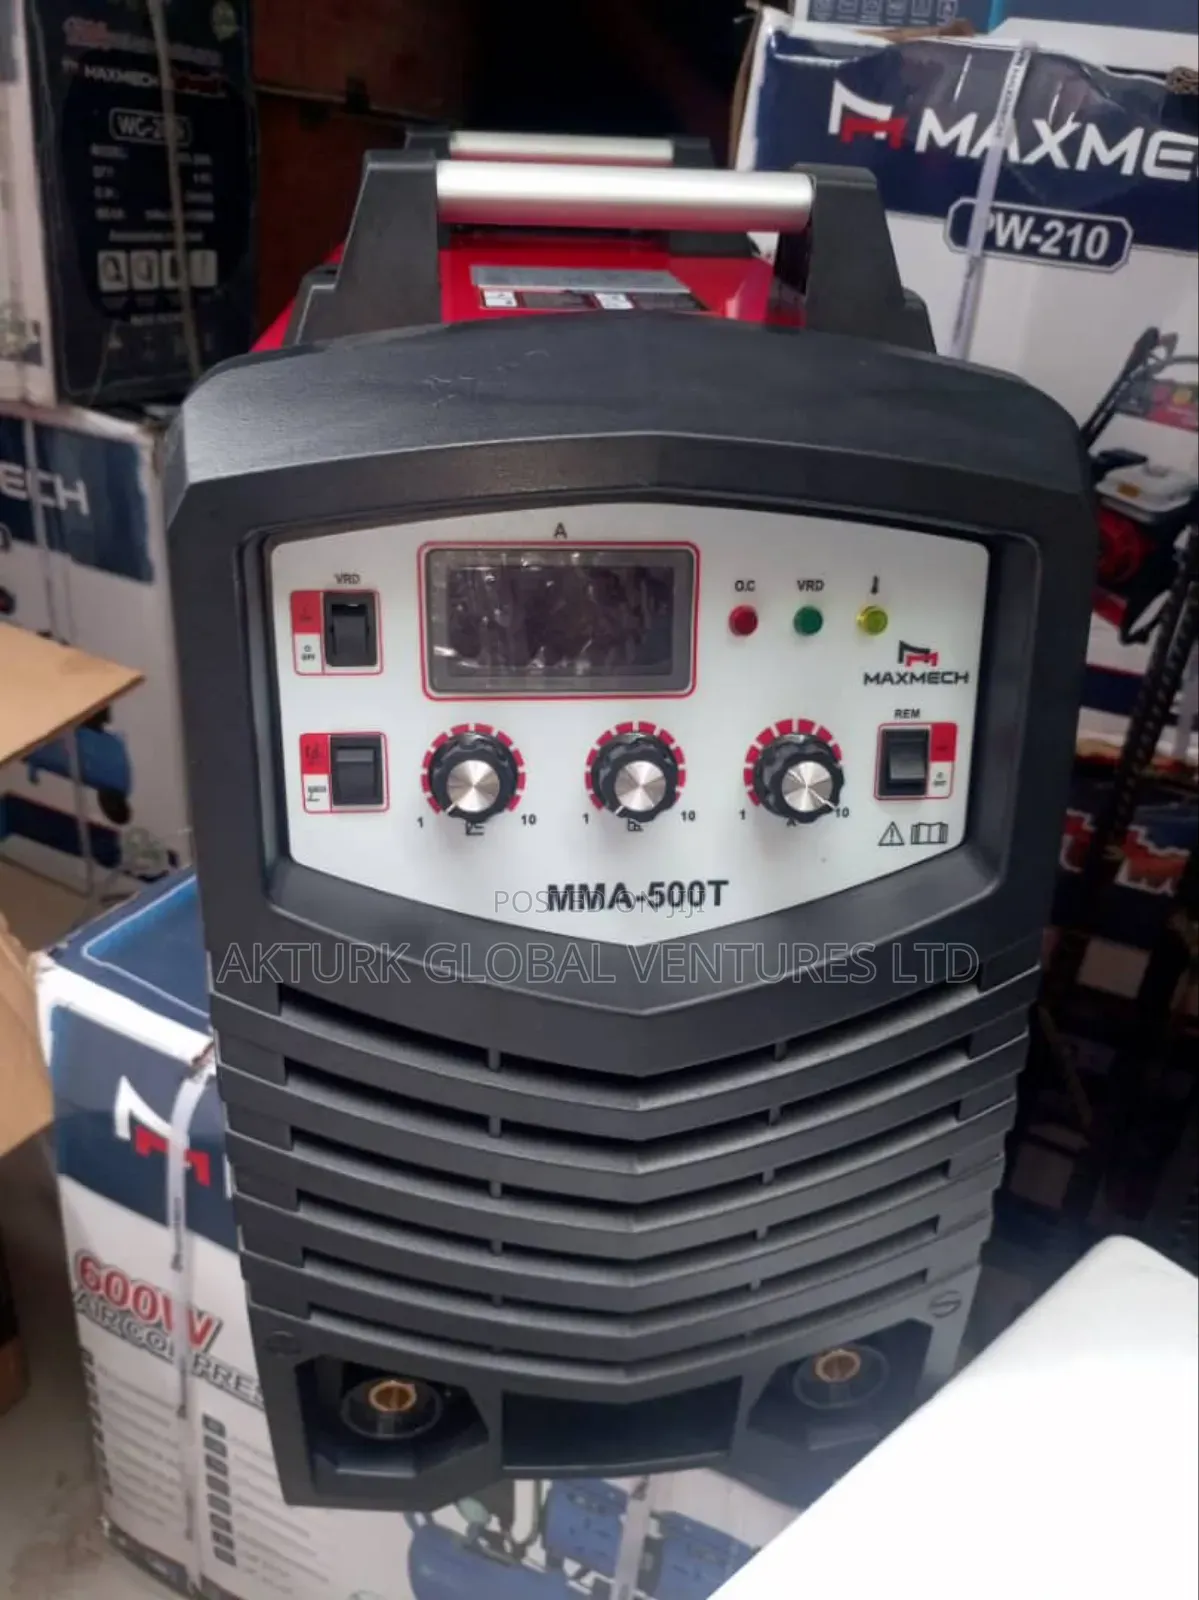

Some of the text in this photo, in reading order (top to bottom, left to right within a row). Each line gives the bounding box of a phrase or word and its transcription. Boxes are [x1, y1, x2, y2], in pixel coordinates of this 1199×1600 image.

[916, 107, 1199, 182] MAXME
[553, 522, 568, 540] A
[335, 572, 361, 585] VRD
[797, 579, 825, 592] VRD
[863, 670, 970, 686] MAXMECH
[894, 707, 921, 720] REM
[520, 811, 537, 825] 10
[583, 810, 589, 823] 1
[680, 810, 696, 822] 10
[739, 809, 746, 821] 1
[834, 805, 849, 819] 10
[416, 816, 424, 829] 1
[547, 879, 730, 912] MMA-500T
